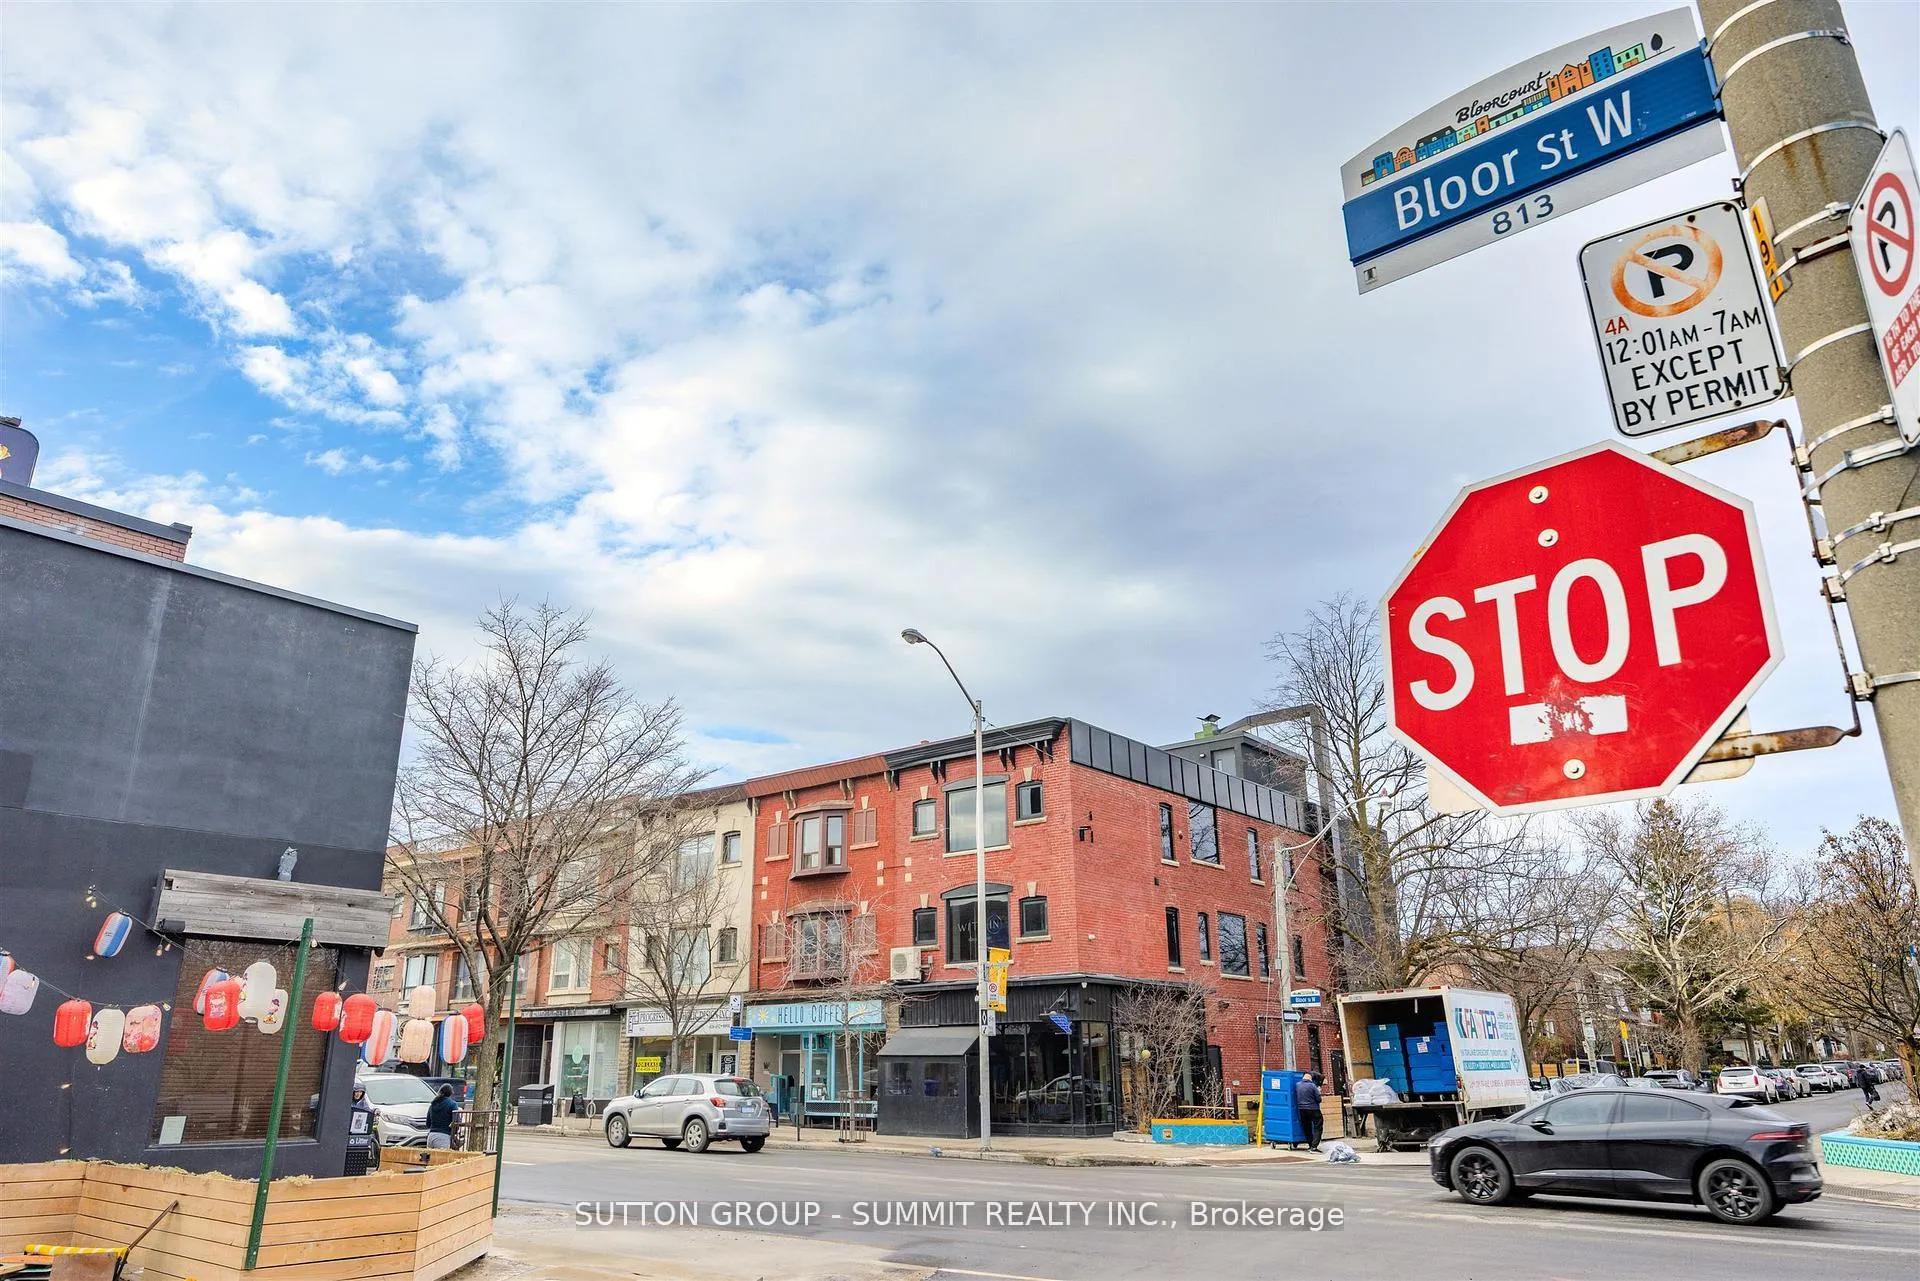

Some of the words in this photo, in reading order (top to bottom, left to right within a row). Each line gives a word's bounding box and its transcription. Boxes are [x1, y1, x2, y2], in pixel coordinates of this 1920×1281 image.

[1393, 147, 1520, 231] Bloor
[1537, 128, 1578, 171] St
[1587, 90, 1633, 147] W
[1492, 194, 1555, 236] 813
[1605, 316, 1630, 335] 4A
[1631, 338, 1744, 392] EXCEPT
[1622, 397, 1663, 427] BY
[1665, 364, 1771, 416] PERMIT
[1408, 533, 1729, 712] STOP
[777, 1005, 804, 1024] HELLO
